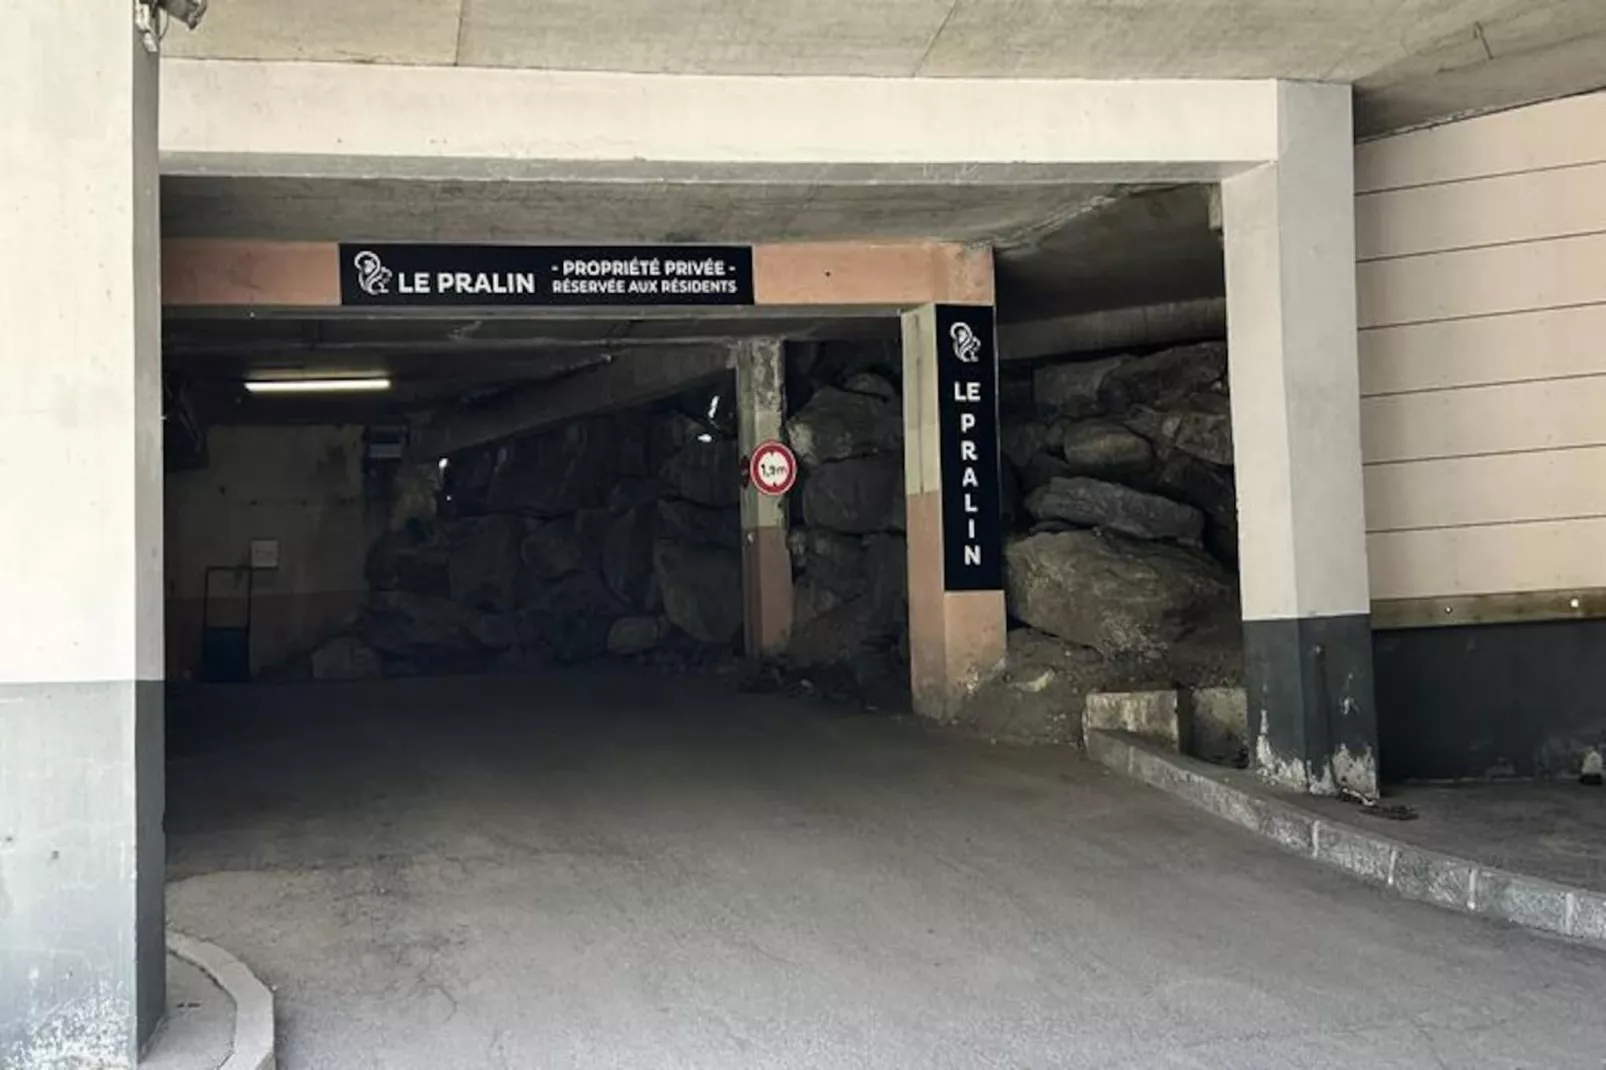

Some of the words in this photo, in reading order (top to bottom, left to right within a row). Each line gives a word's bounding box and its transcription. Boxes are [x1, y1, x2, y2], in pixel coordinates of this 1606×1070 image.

[562, 257, 661, 276] PROPRIÉTÉ
[664, 257, 726, 276] PRIVÉE
[398, 272, 430, 294] LE
[437, 272, 535, 294] PRALIN
[552, 277, 626, 294] RÉSERVÉE
[628, 279, 658, 294] AUX
[661, 277, 738, 294] RÉSIDENTS
[954, 381, 981, 402] LE
[960, 413, 981, 566] PRALIN
